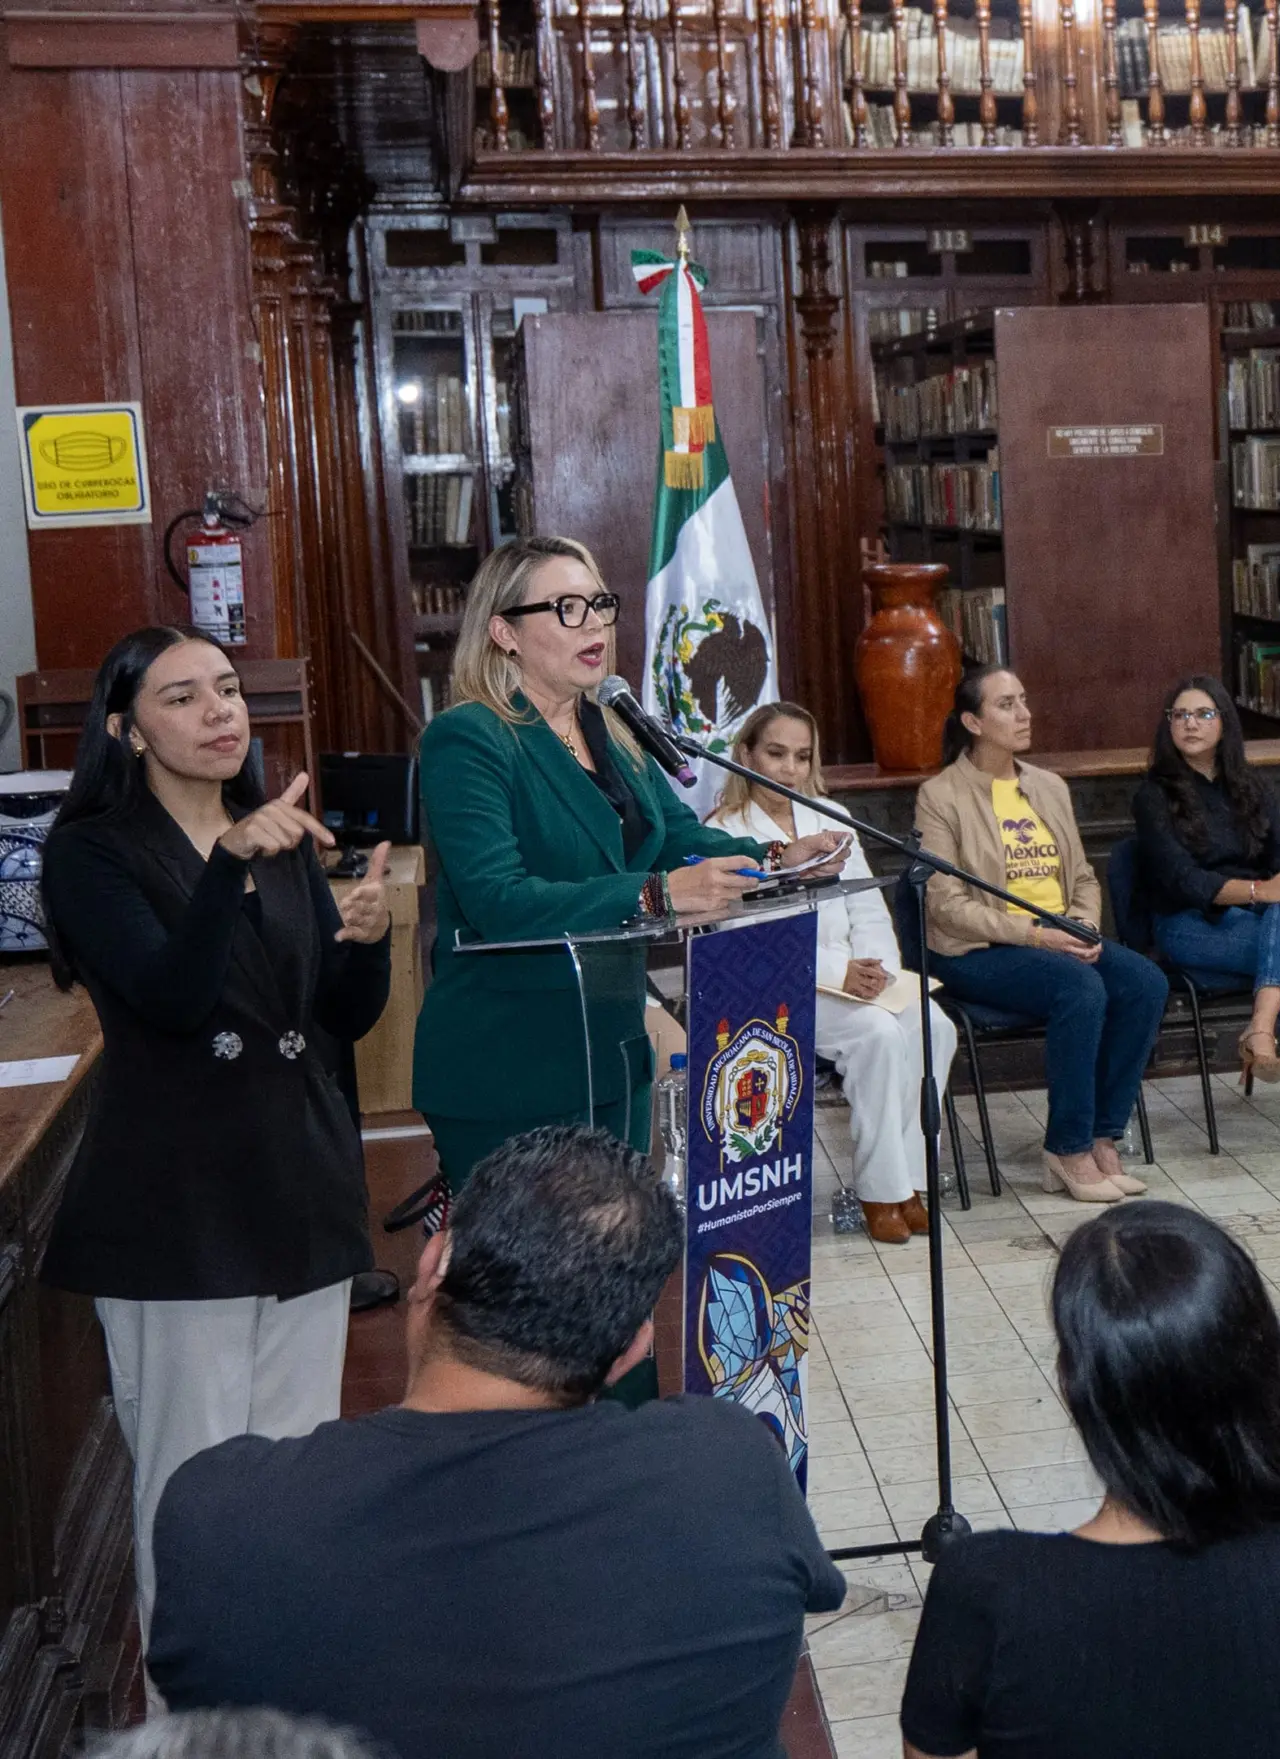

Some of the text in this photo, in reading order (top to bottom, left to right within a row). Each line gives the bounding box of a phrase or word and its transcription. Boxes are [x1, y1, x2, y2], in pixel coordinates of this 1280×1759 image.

[932, 230, 966, 249] 113
[1189, 225, 1224, 244] 114
[1006, 862, 1057, 880] orazón
[705, 1074, 718, 1131] UNIVERSIDAD
[713, 1030, 752, 1073] MICHOACANA
[752, 1027, 761, 1037] DE
[761, 1029, 774, 1042] SAN
[785, 1072, 798, 1109] HIDALGO
[698, 1153, 802, 1211] UMSNH
[697, 1192, 802, 1234] #HumanistaPorSiempre
